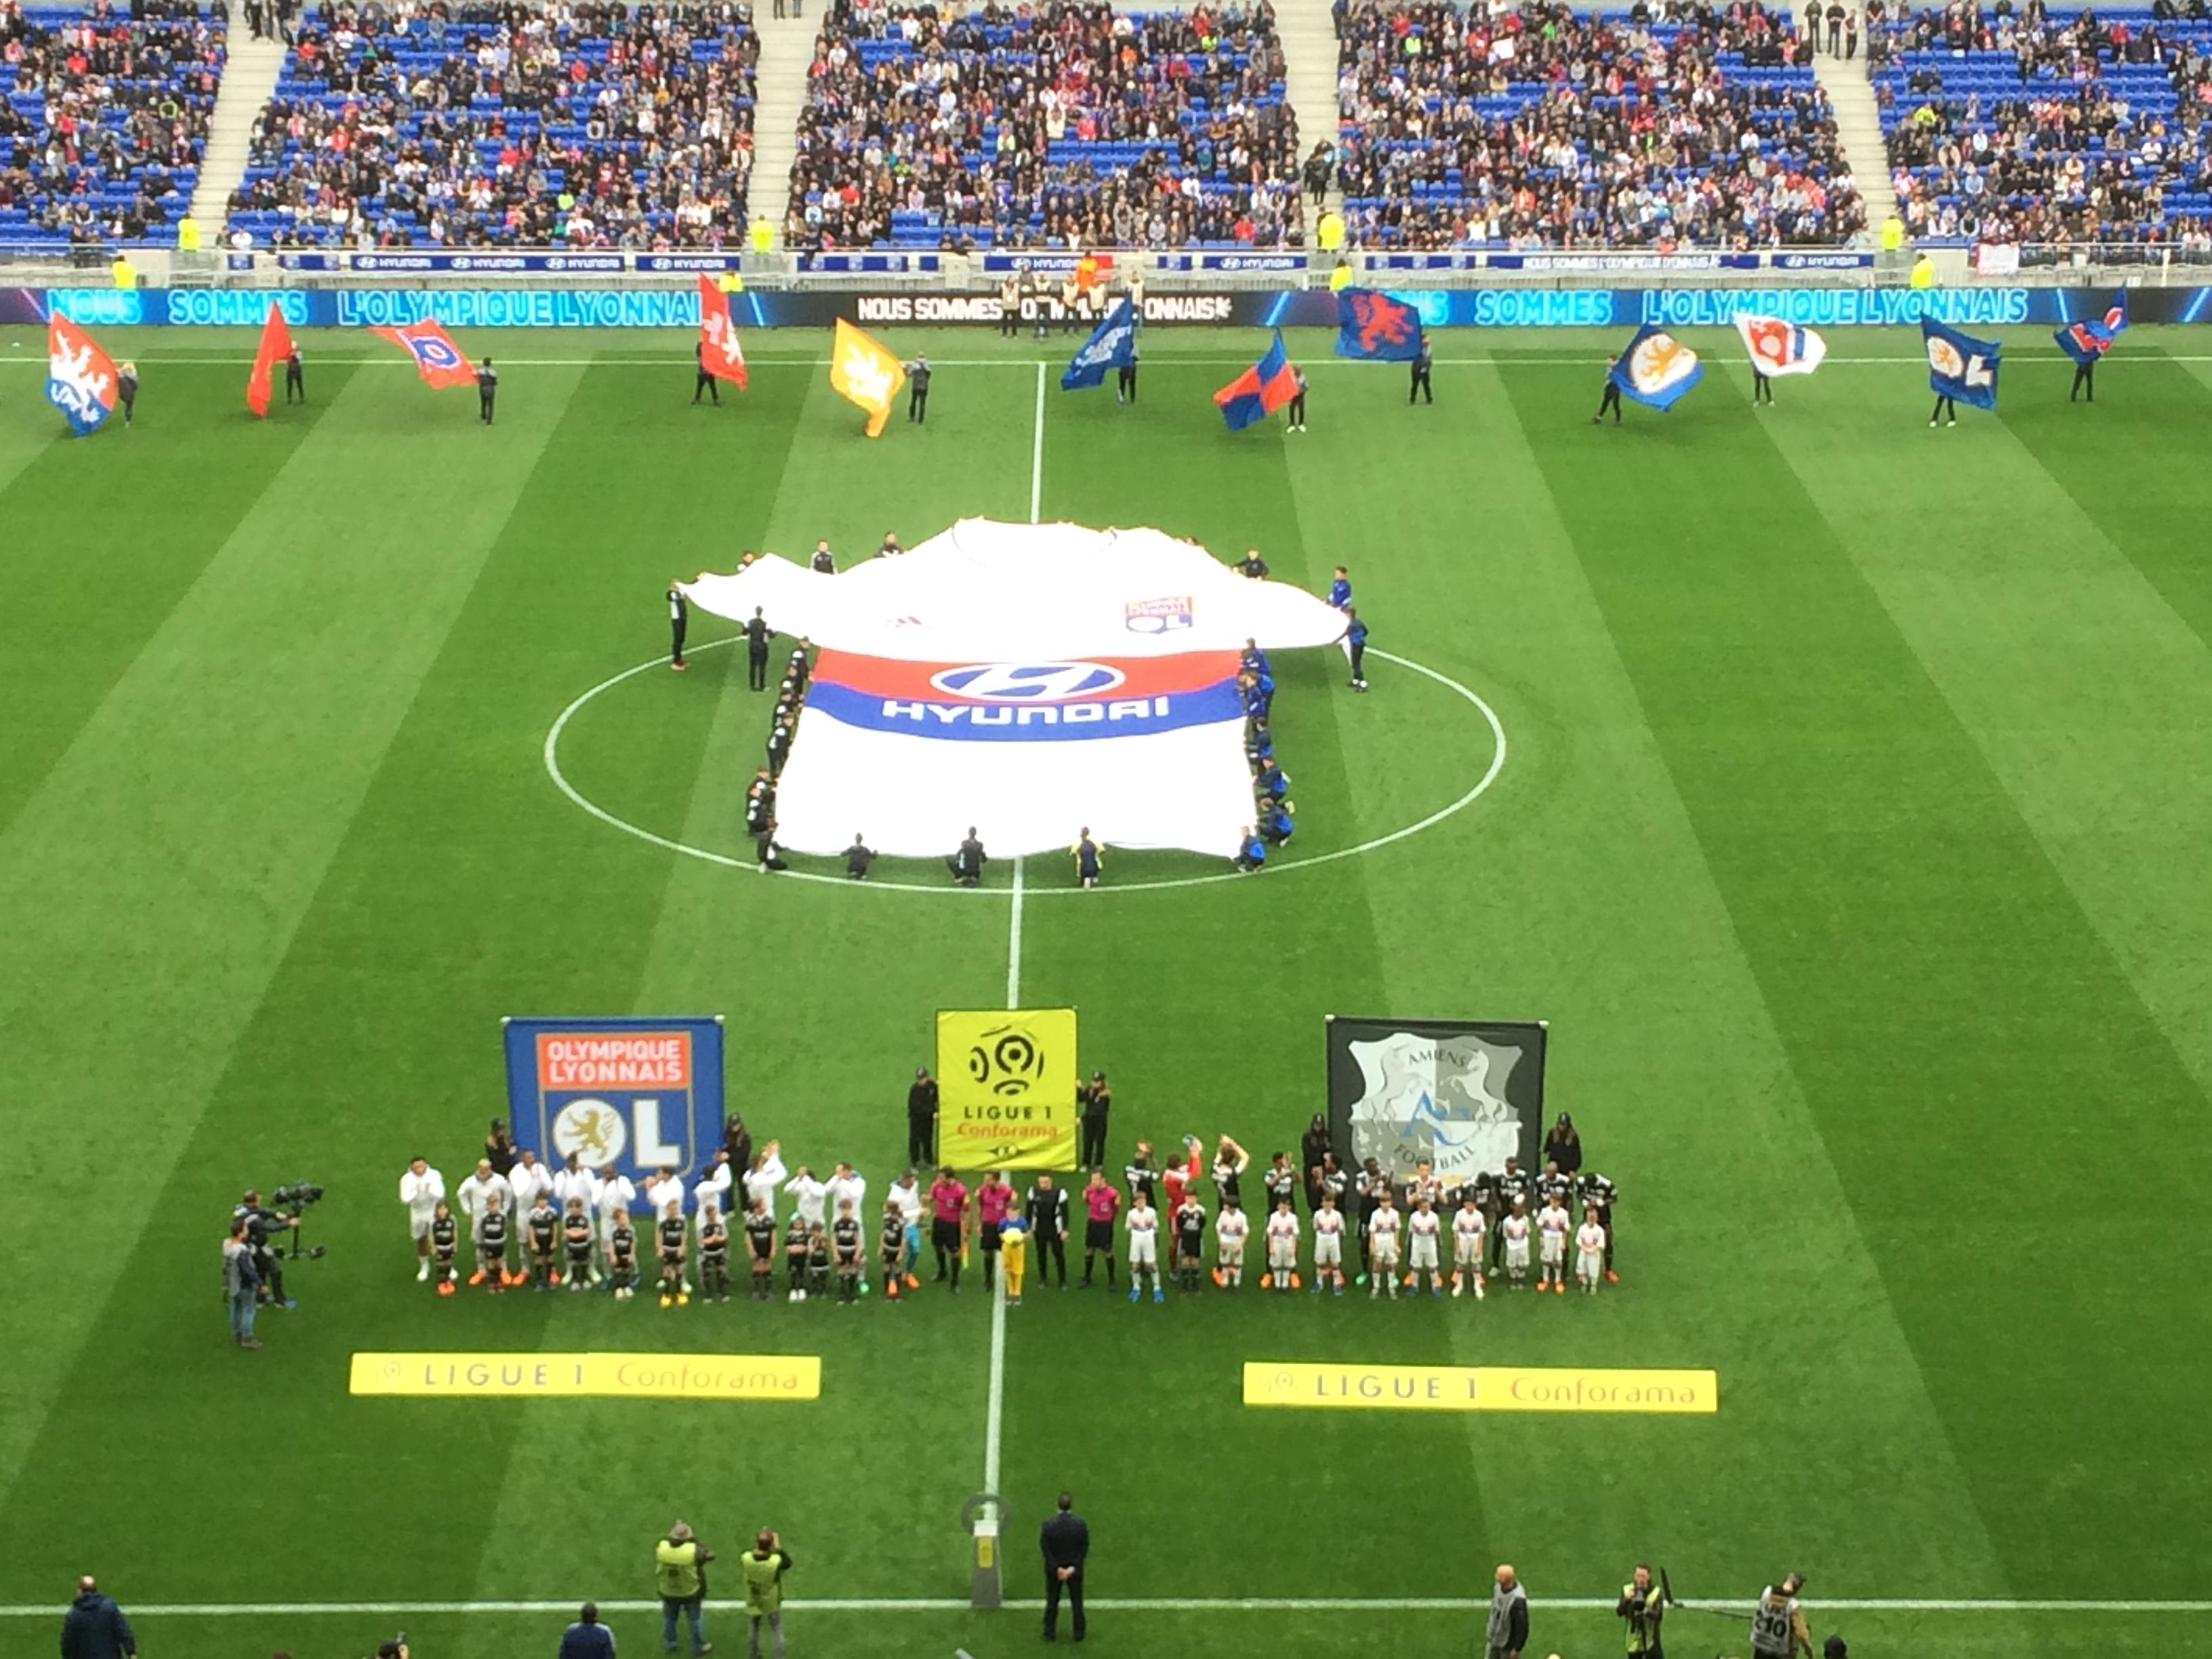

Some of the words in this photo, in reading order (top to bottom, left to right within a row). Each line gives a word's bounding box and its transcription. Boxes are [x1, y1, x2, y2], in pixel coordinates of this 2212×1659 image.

[337, 290, 554, 325] L'OLYMPIQUE
[556, 290, 701, 325] LYONNAI
[858, 298, 911, 320] NOUS
[915, 298, 1003, 320] SOMMES
[1475, 289, 1612, 325] SOMMES
[1642, 289, 1858, 325] L'OLYMPIQUE
[1861, 288, 2028, 324] LYONNAIS
[882, 696, 1169, 725] HYUNDAI
[547, 1039, 681, 1062] OLYMPIQUE
[1410, 1049, 1466, 1067] AMIENS
[550, 1061, 683, 1084] LYONNAIS
[964, 1106, 1033, 1120] LIGUE
[1045, 1106, 1052, 1120] 1
[957, 1122, 1059, 1139] Conforama
[1394, 1143, 1475, 1171] FOTBALL
[424, 1363, 548, 1387] LIGUE
[575, 1364, 582, 1387] 1
[617, 1361, 798, 1391] Conforama
[1317, 1374, 1441, 1400] LIGUE
[1466, 1377, 1475, 1399] 1
[1511, 1376, 1696, 1406] Conforama
